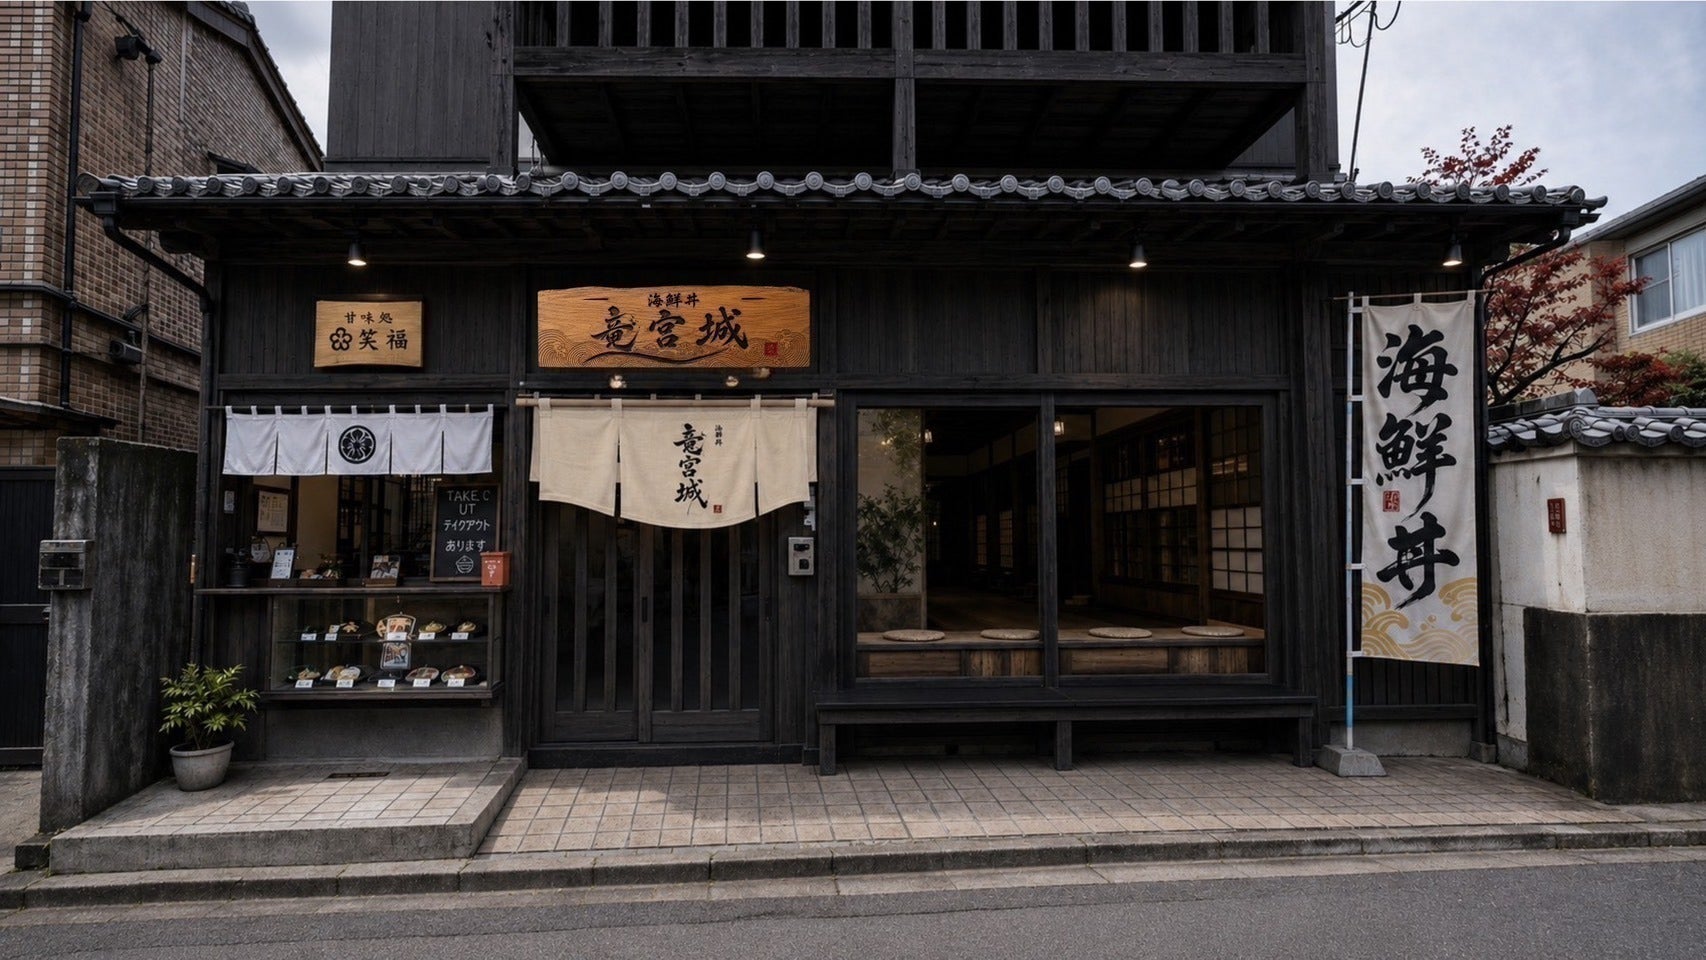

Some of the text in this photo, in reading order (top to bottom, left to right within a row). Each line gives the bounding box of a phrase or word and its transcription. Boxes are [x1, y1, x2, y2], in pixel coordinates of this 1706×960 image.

[344, 311, 393, 324] 甘味処
[591, 306, 748, 350] 竜宮城
[358, 328, 409, 351] 笑福
[673, 423, 708, 512] 竜宮城
[459, 503, 476, 515] UT
[445, 539, 486, 552] あります
